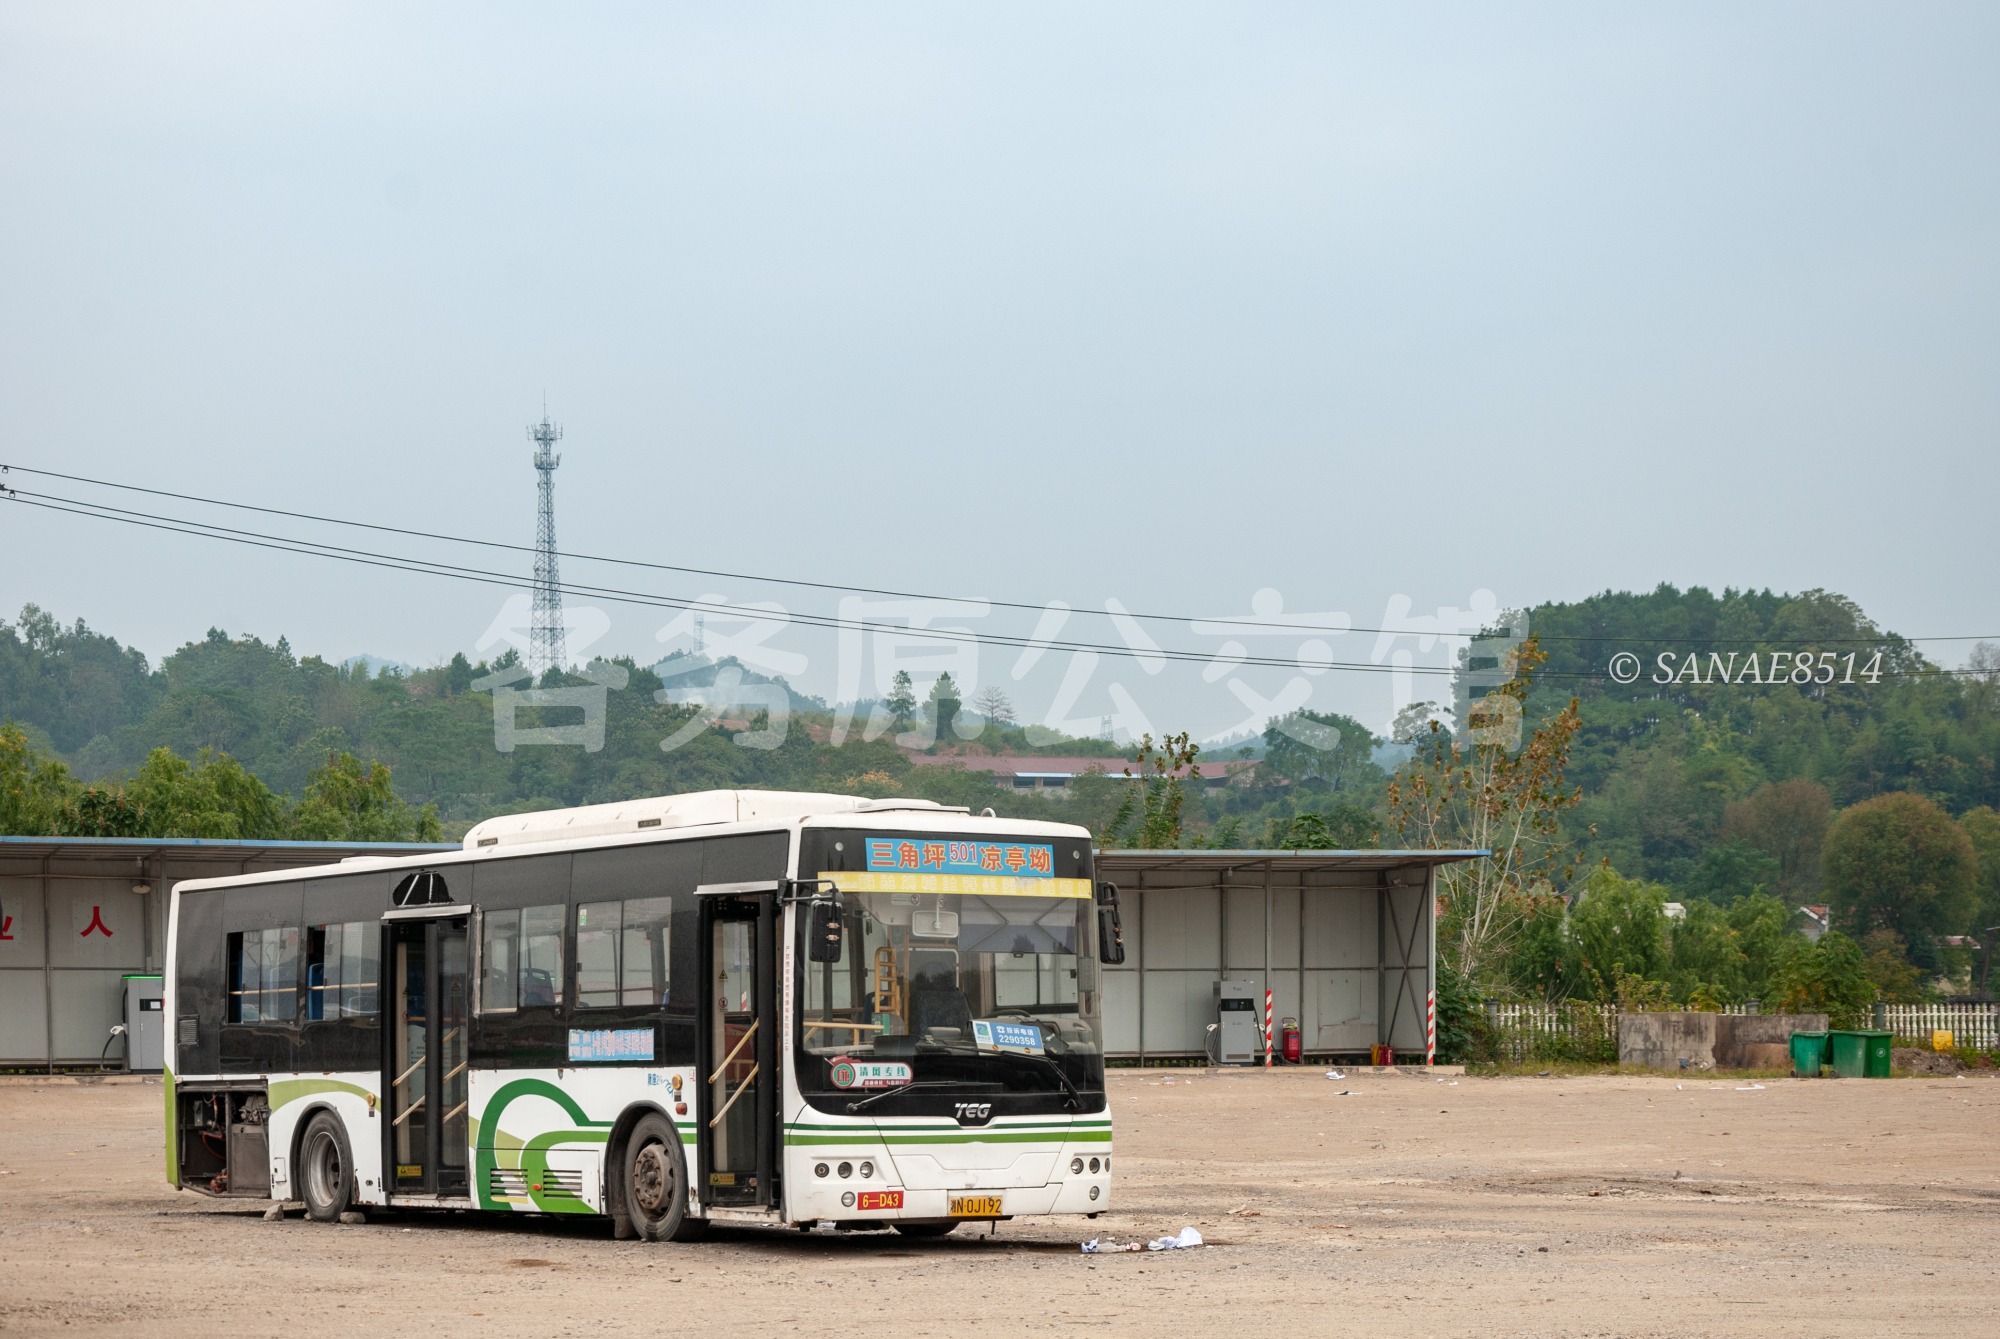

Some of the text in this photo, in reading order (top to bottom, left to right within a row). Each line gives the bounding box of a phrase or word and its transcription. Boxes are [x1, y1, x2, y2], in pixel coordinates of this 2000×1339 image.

[871, 841, 1051, 873] 三角坪 501 凉亭坳
[80, 906, 113, 937] 人
[1006, 1026, 1034, 1036] 投诉电话
[998, 1034, 1036, 1046] 2290358
[954, 1102, 992, 1119] TEG
